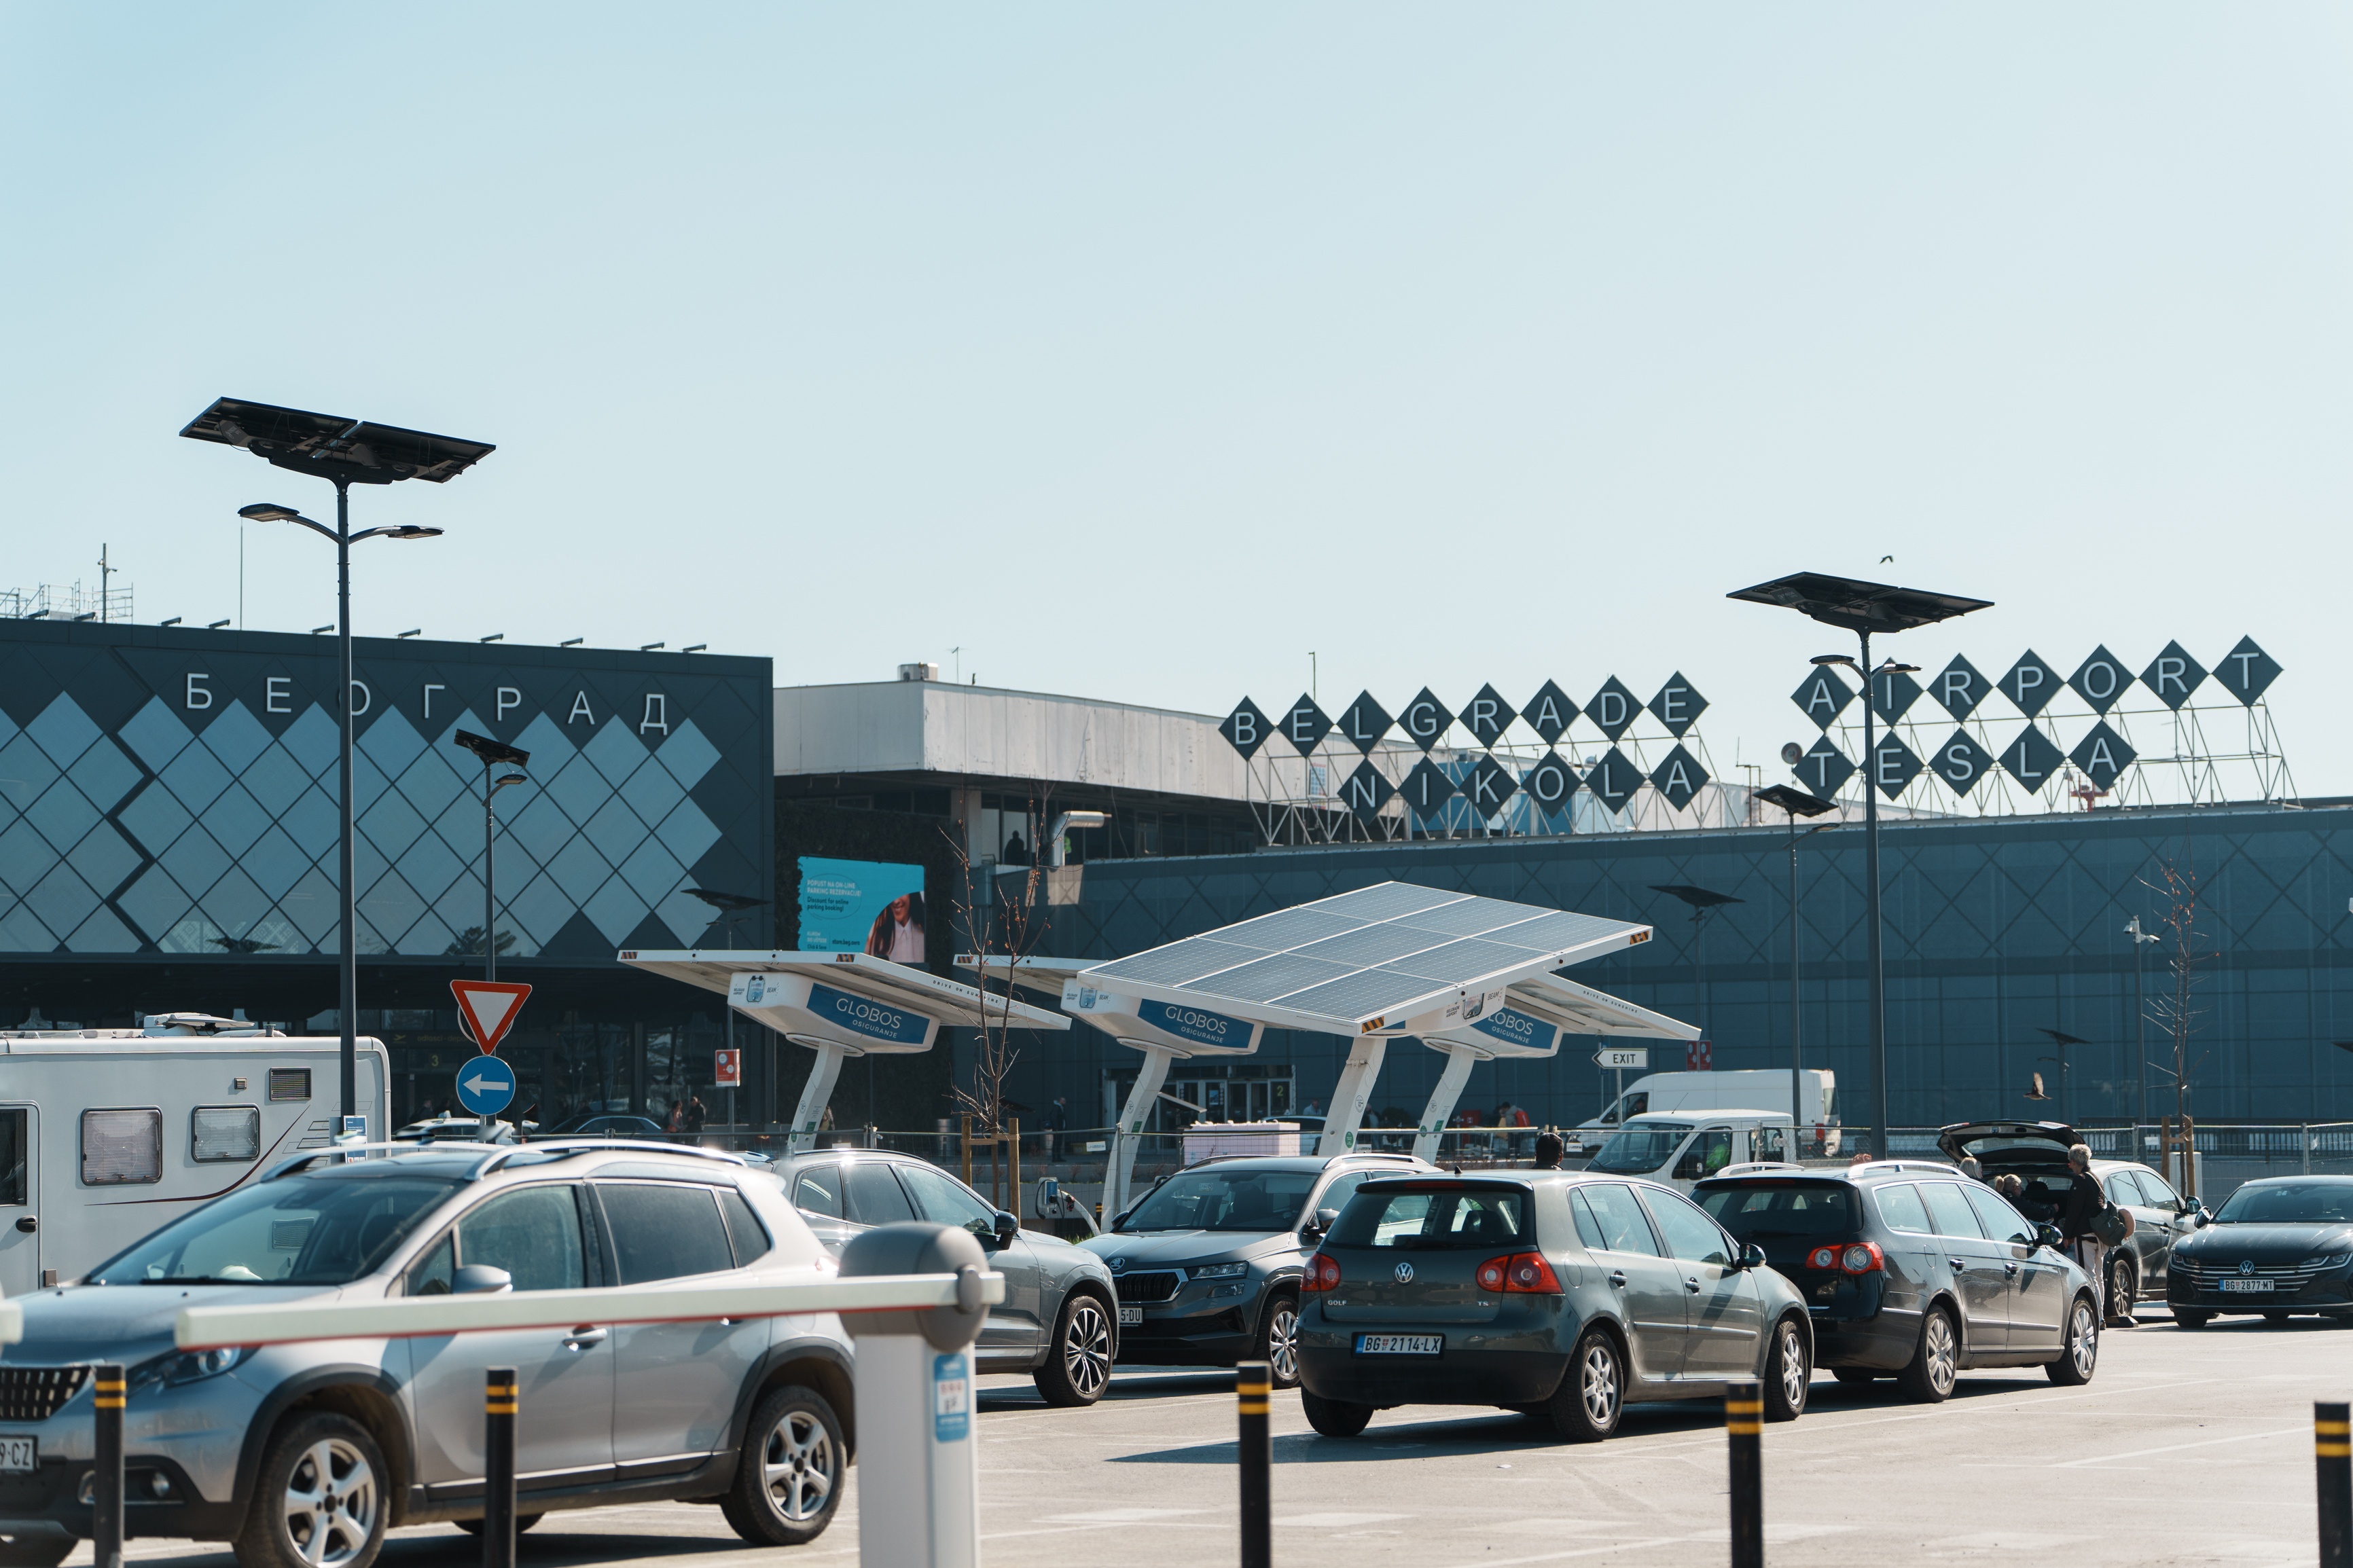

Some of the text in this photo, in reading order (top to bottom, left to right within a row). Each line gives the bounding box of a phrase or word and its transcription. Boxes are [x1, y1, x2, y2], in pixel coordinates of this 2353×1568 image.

[1809, 651, 2261, 714] AIRPORT
[186, 672, 668, 735] БЕОГРАД
[1234, 687, 1688, 746] BELGRADE
[1810, 737, 2119, 788] TESLA
[1352, 759, 1694, 809] NIKOLA
[825, 905, 844, 913] booking!
[933, 980, 952, 989] DRIVE
[1488, 991, 1500, 1000] BEAM
[1583, 990, 1599, 999] DRIVE
[1611, 1000, 1638, 1013] SUNSHINE
[836, 998, 902, 1029] GLOBOS
[1446, 1005, 1460, 1014] BELGRADE
[852, 1019, 898, 1038] OSIGURANJE
[1166, 1006, 1228, 1034] GLOBOS
[1488, 1012, 1534, 1035] LOBOS
[1181, 1026, 1224, 1044] OSIGURANJE
[1492, 1026, 1530, 1044] OSIGURANJE
[431, 1055, 439, 1067] 3
[1613, 1054, 1636, 1064] EXIT
[1277, 1086, 1284, 1097] 2
[2225, 1281, 2235, 1290] BG
[1365, 1337, 1381, 1351] BG
